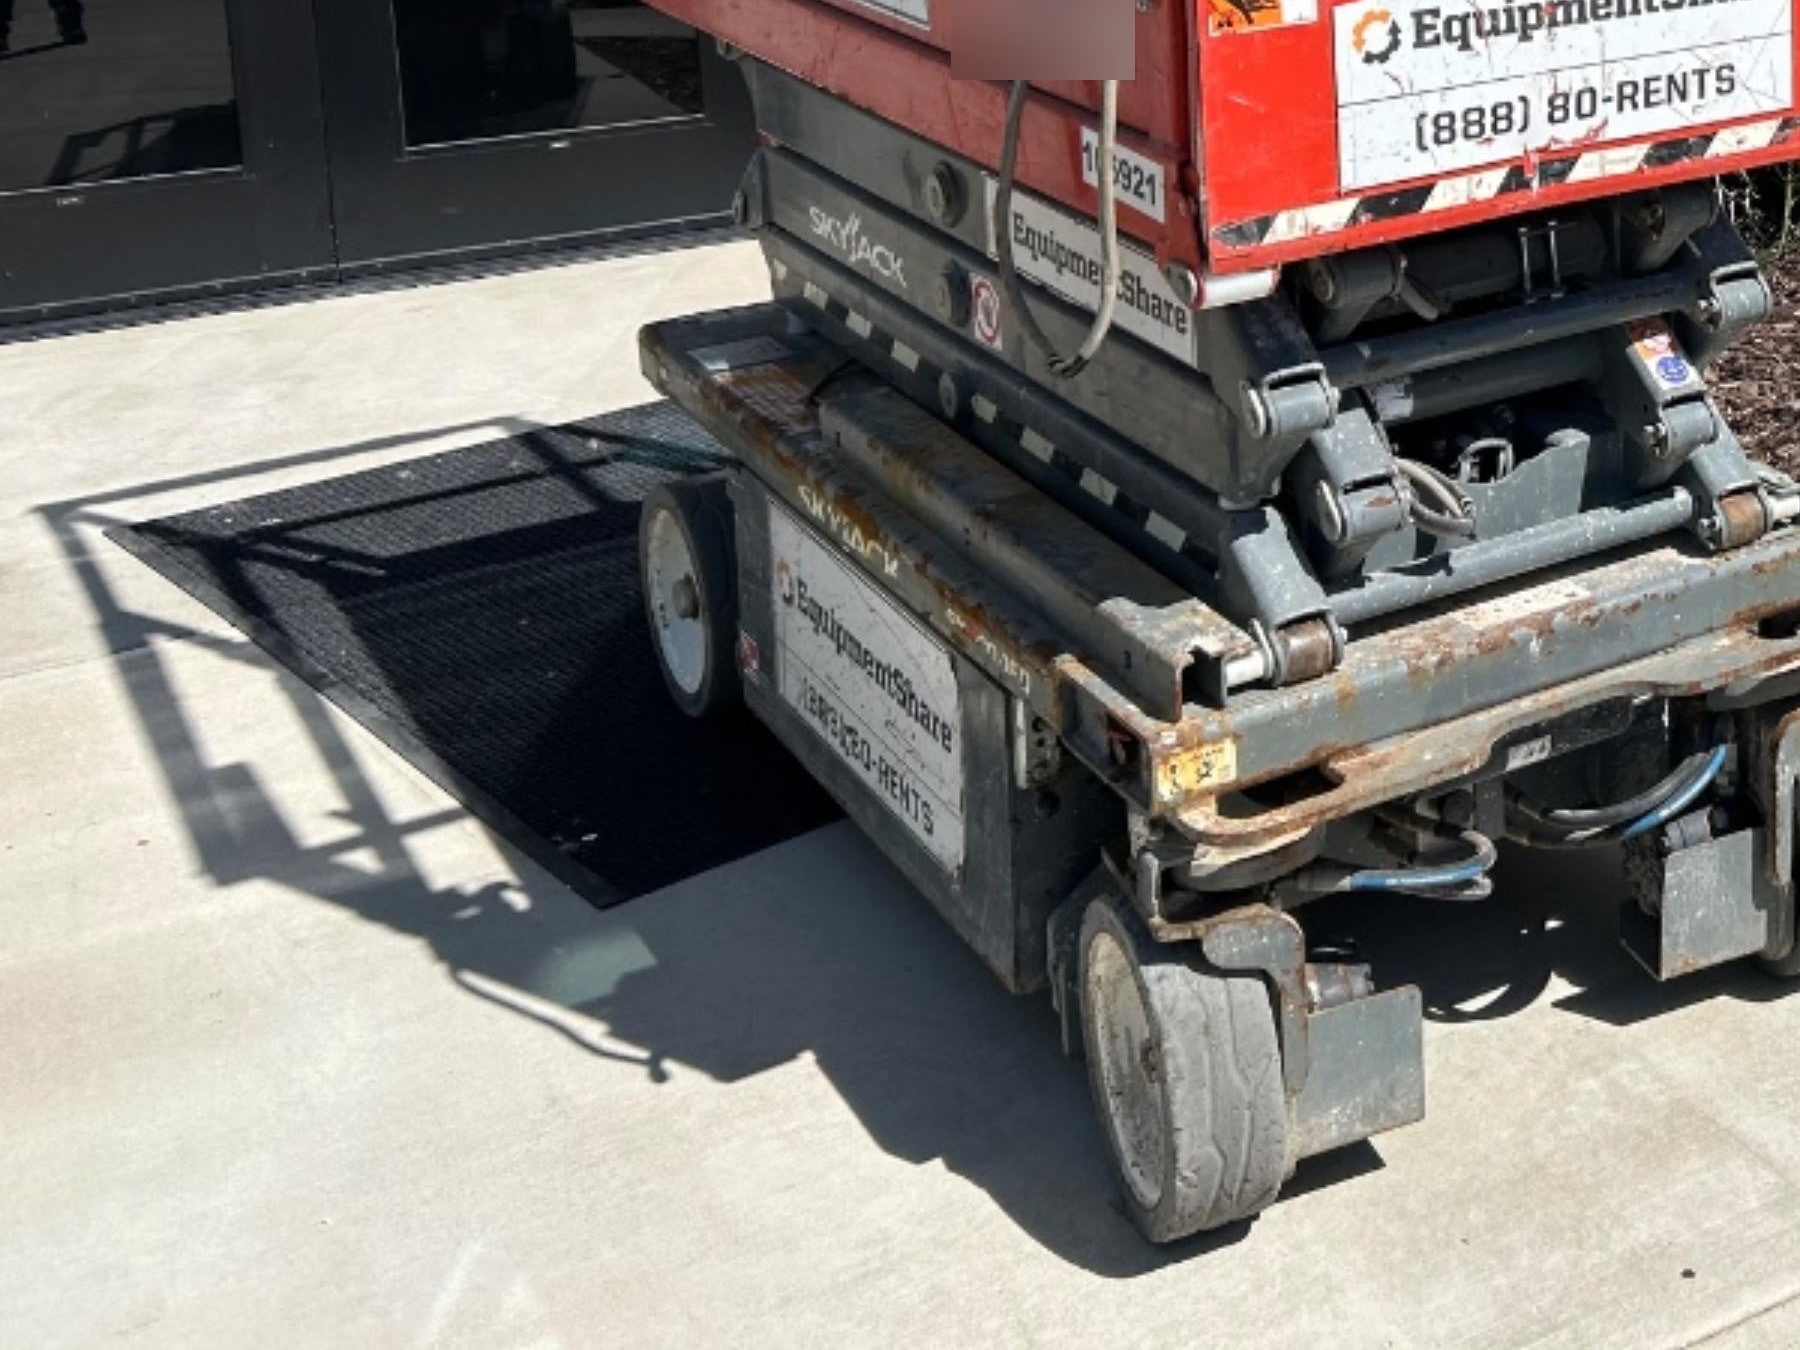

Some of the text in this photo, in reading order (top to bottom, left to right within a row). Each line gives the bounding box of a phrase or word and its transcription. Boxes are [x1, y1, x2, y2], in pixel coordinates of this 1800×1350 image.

[1414, 63, 1737, 152] (888) 80-RENTS
[1013, 211, 1188, 335] EquipmeShare
[797, 577, 952, 754] EquipmentShare
